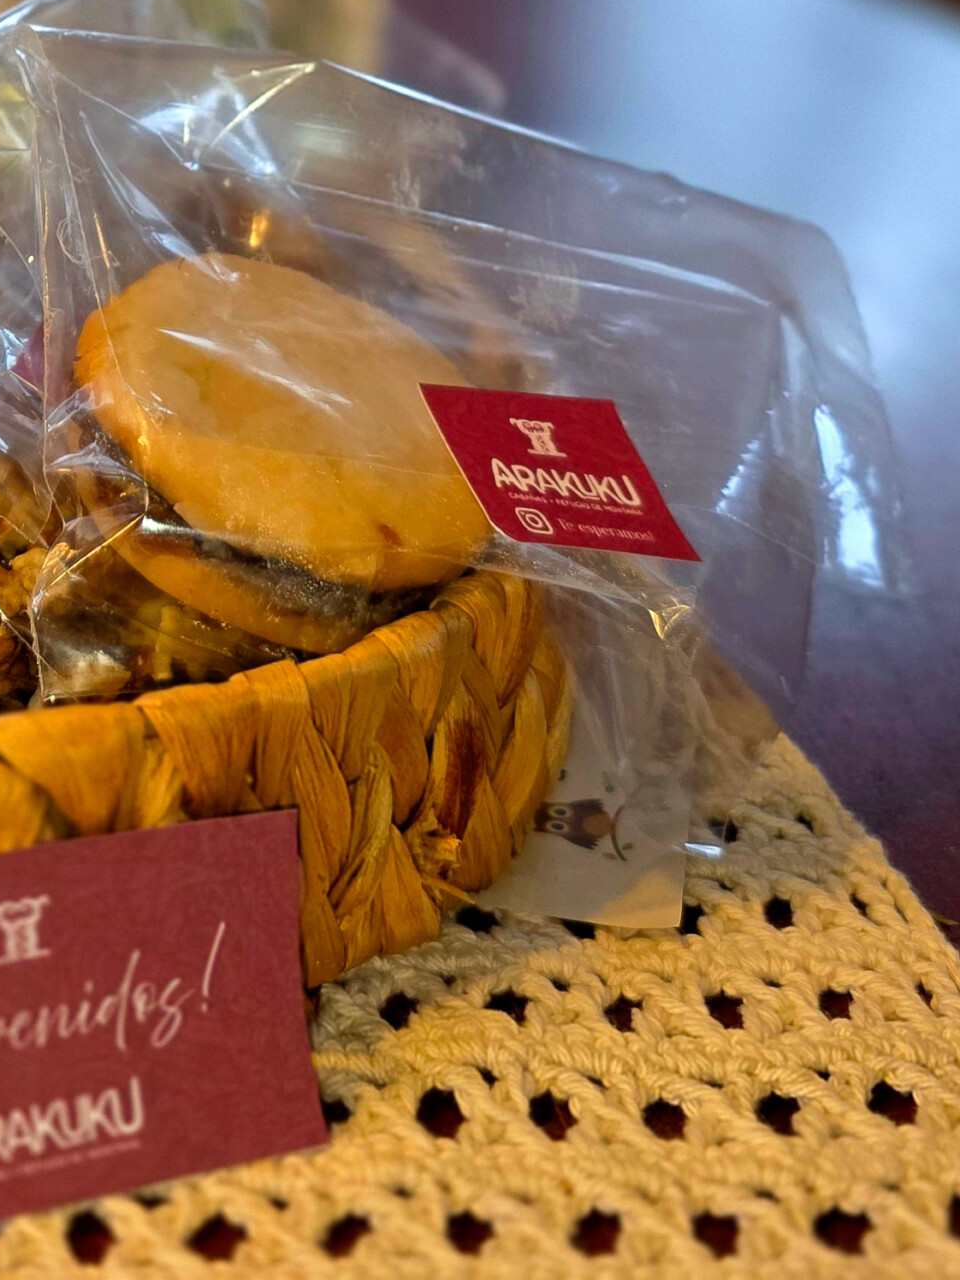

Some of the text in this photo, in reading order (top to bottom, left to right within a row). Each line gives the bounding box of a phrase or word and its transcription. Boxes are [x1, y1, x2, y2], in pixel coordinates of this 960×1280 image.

[491, 458, 643, 506] ARAKUKU
[558, 519, 656, 542] Te esperamos!
